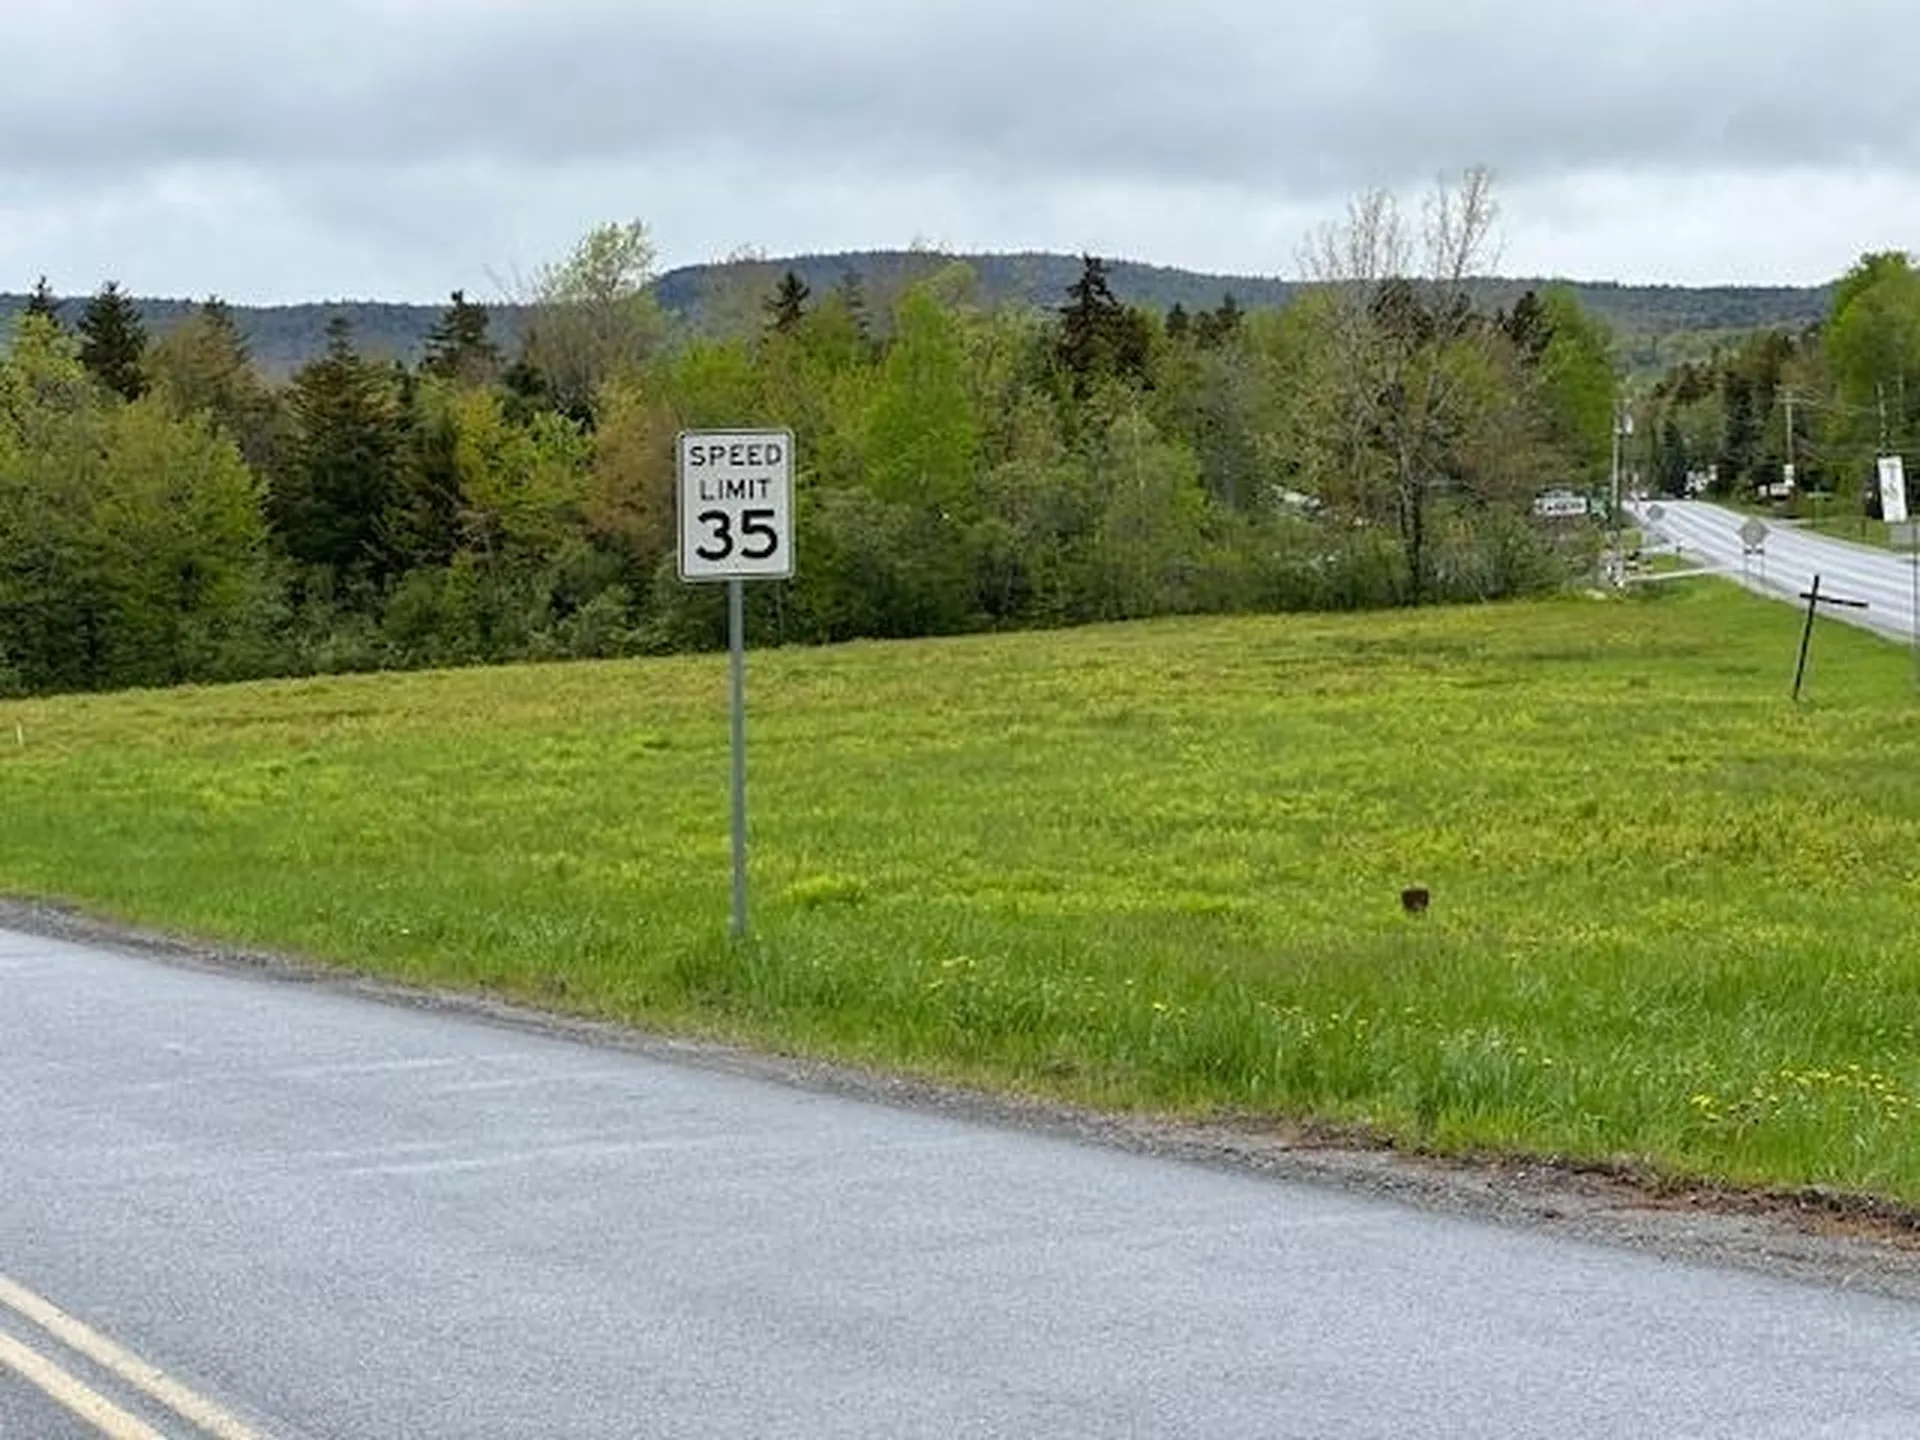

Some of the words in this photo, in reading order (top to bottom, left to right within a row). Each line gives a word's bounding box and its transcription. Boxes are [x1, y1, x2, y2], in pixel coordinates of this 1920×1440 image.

[690, 444, 782, 466] SPEED
[700, 478, 771, 501] LIMIT
[696, 509, 778, 561] 35
